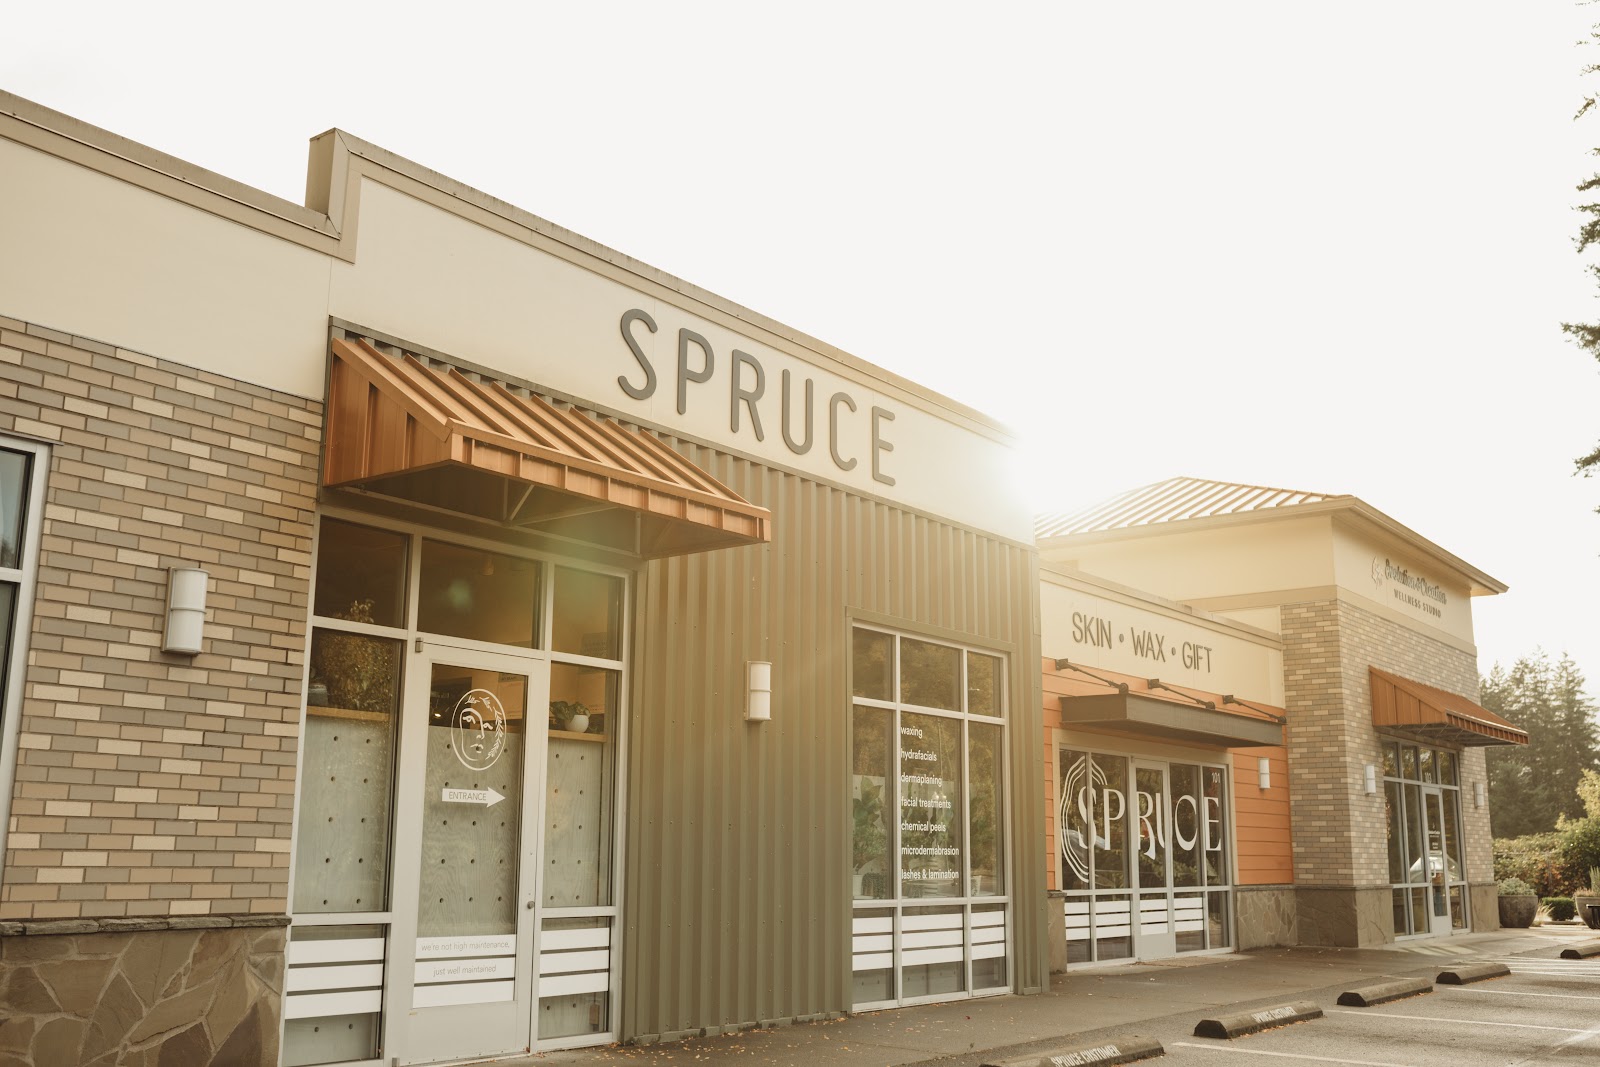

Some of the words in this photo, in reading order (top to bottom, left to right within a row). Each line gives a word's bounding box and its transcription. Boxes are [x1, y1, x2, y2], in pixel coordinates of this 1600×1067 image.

[618, 308, 896, 487] SPRUCE
[1393, 588, 1421, 609] WELLNESS
[1422, 602, 1441, 618] STUDIO
[1072, 611, 1112, 650] SKIN
[1130, 627, 1166, 663] WAX
[1182, 641, 1212, 673] GIFT
[901, 725, 923, 739] waxing
[900, 748, 937, 762] hydrafacials
[901, 772, 942, 787] dermaplaning
[1211, 771, 1221, 784] 101
[448, 791, 487, 801] ENTRANCE
[901, 796, 918, 807] facial
[919, 798, 952, 809] treatments
[901, 820, 929, 832] chemical
[930, 822, 947, 833] peels
[1077, 785, 1222, 860] SPRUCE
[901, 844, 960, 856] microdermabrasion
[901, 868, 921, 879] lashes
[922, 868, 928, 879] &
[929, 868, 960, 879] lamination
[421, 943, 440, 951] we're
[441, 943, 452, 951] not
[454, 941, 467, 951] high
[433, 967, 446, 977] just
[447, 965, 460, 975] well
[462, 964, 497, 974] maintained
[1049, 1052, 1085, 1067] SPRUCE
[1079, 1044, 1122, 1063] CUSTOMER
